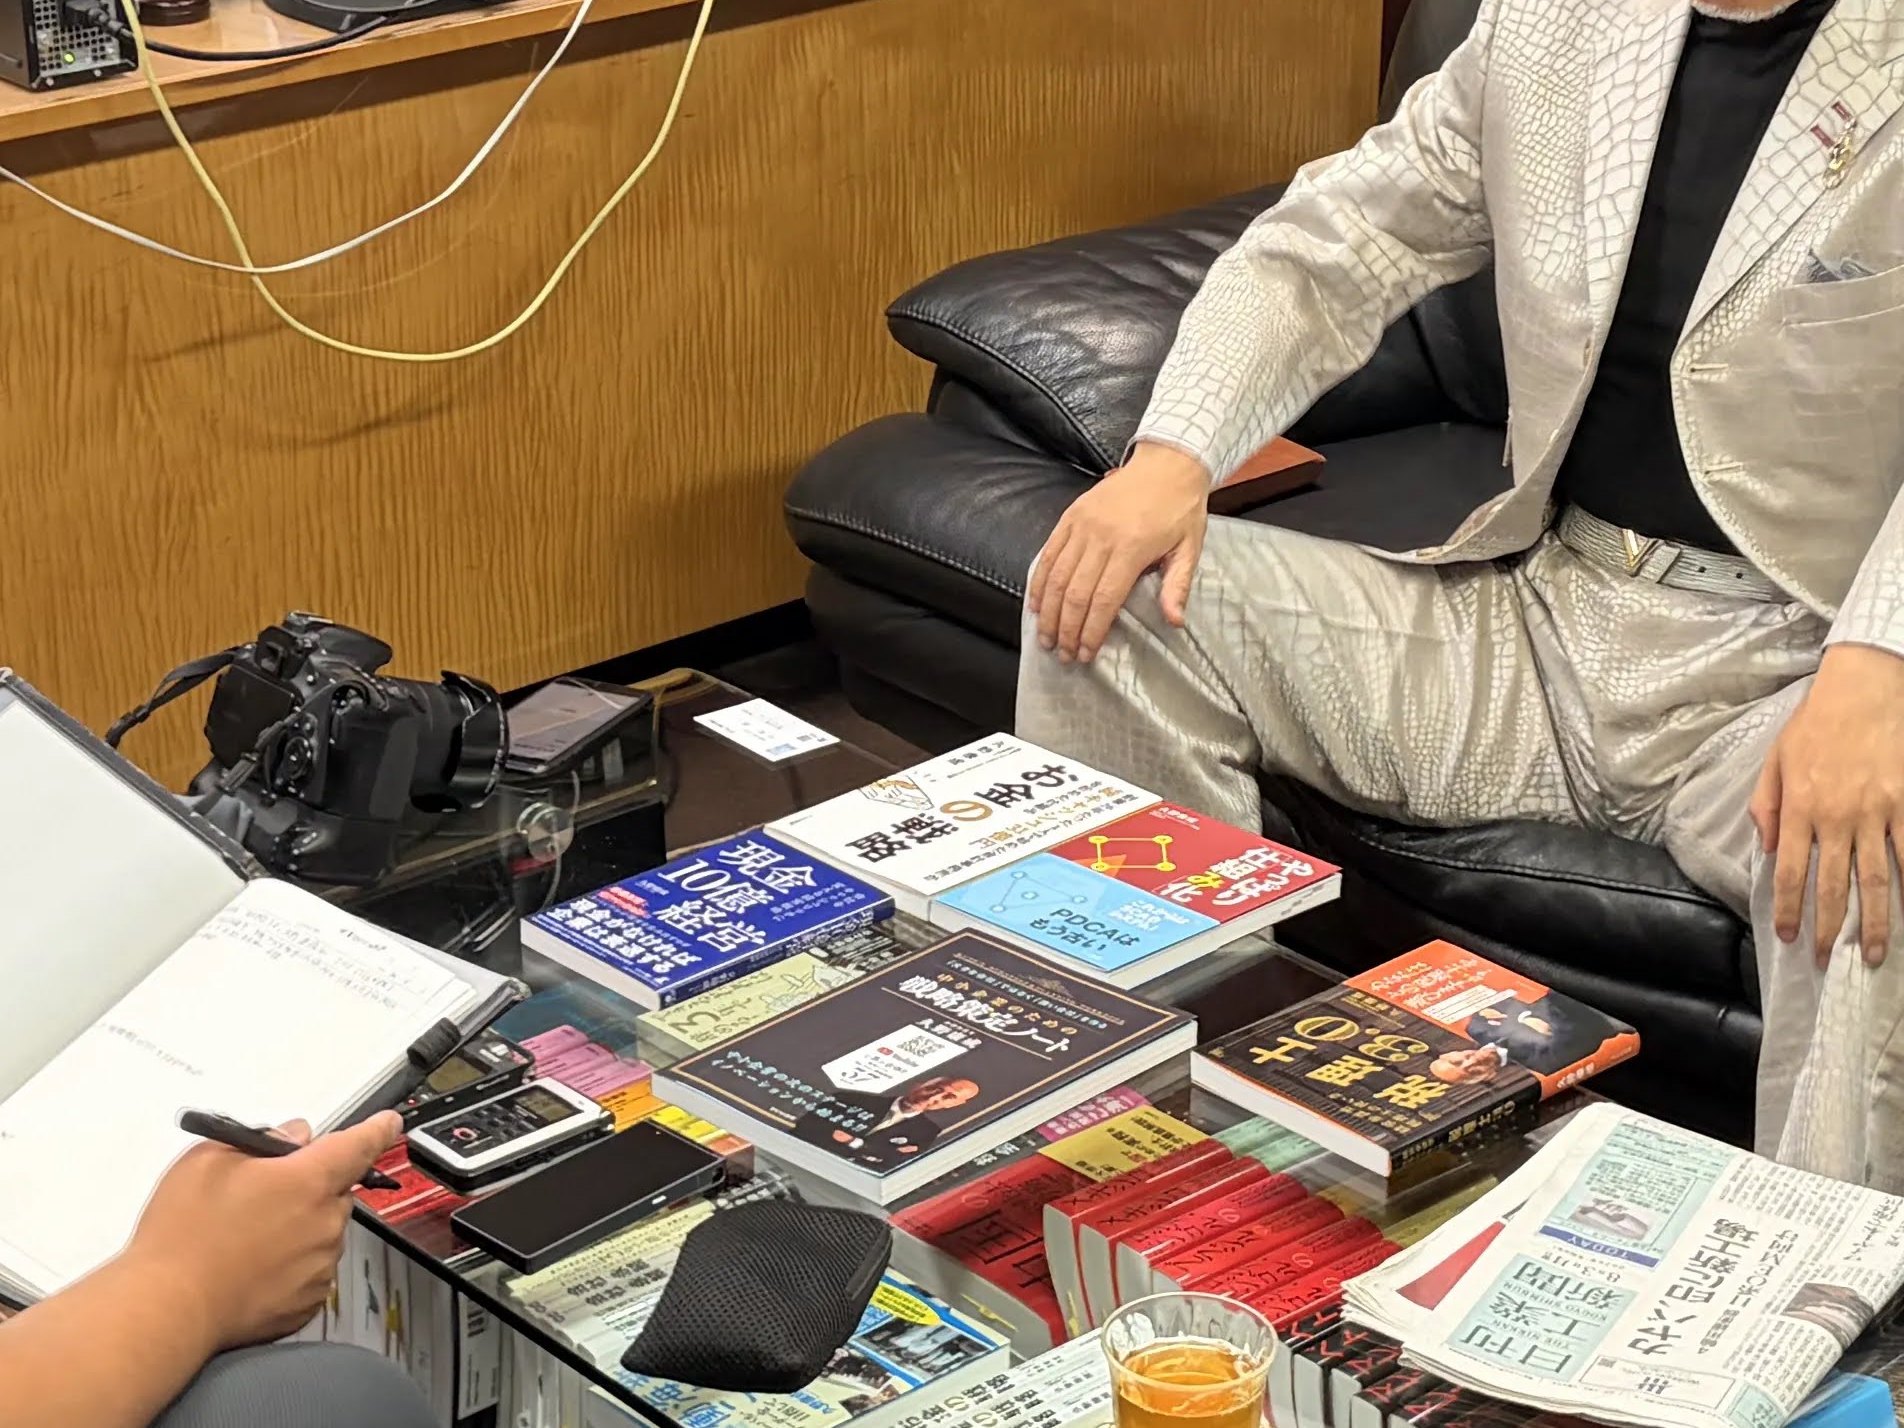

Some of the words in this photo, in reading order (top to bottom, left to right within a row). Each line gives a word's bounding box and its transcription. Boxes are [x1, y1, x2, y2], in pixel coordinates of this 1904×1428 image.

[847, 762, 1068, 864] お金の戦略
[657, 858, 774, 914] 10億
[718, 839, 818, 893] 現金
[1152, 846, 1286, 905] 仕組み化
[1211, 852, 1316, 907] やっぱり
[547, 907, 675, 974] 企業は衰退する
[569, 898, 702, 969] 現金がなければ
[652, 899, 769, 953] 経営
[1028, 918, 1107, 955] もう古い
[1051, 907, 1140, 947] PDCAは
[898, 974, 1072, 1055] 戦略策定ノート
[1294, 1015, 1430, 1063] 3.0
[1249, 1034, 1452, 1110] 税理士
[1567, 1233, 1629, 1261] TODAY
[1518, 1262, 1628, 1307] 新聞
[1489, 1294, 1605, 1343] 工業
[1490, 1316, 1542, 1342] NIKKAN
[1562, 1302, 1607, 1326] KOGYO
[1460, 1325, 1574, 1374] 日刊
[1543, 1336, 1571, 1352] THE
